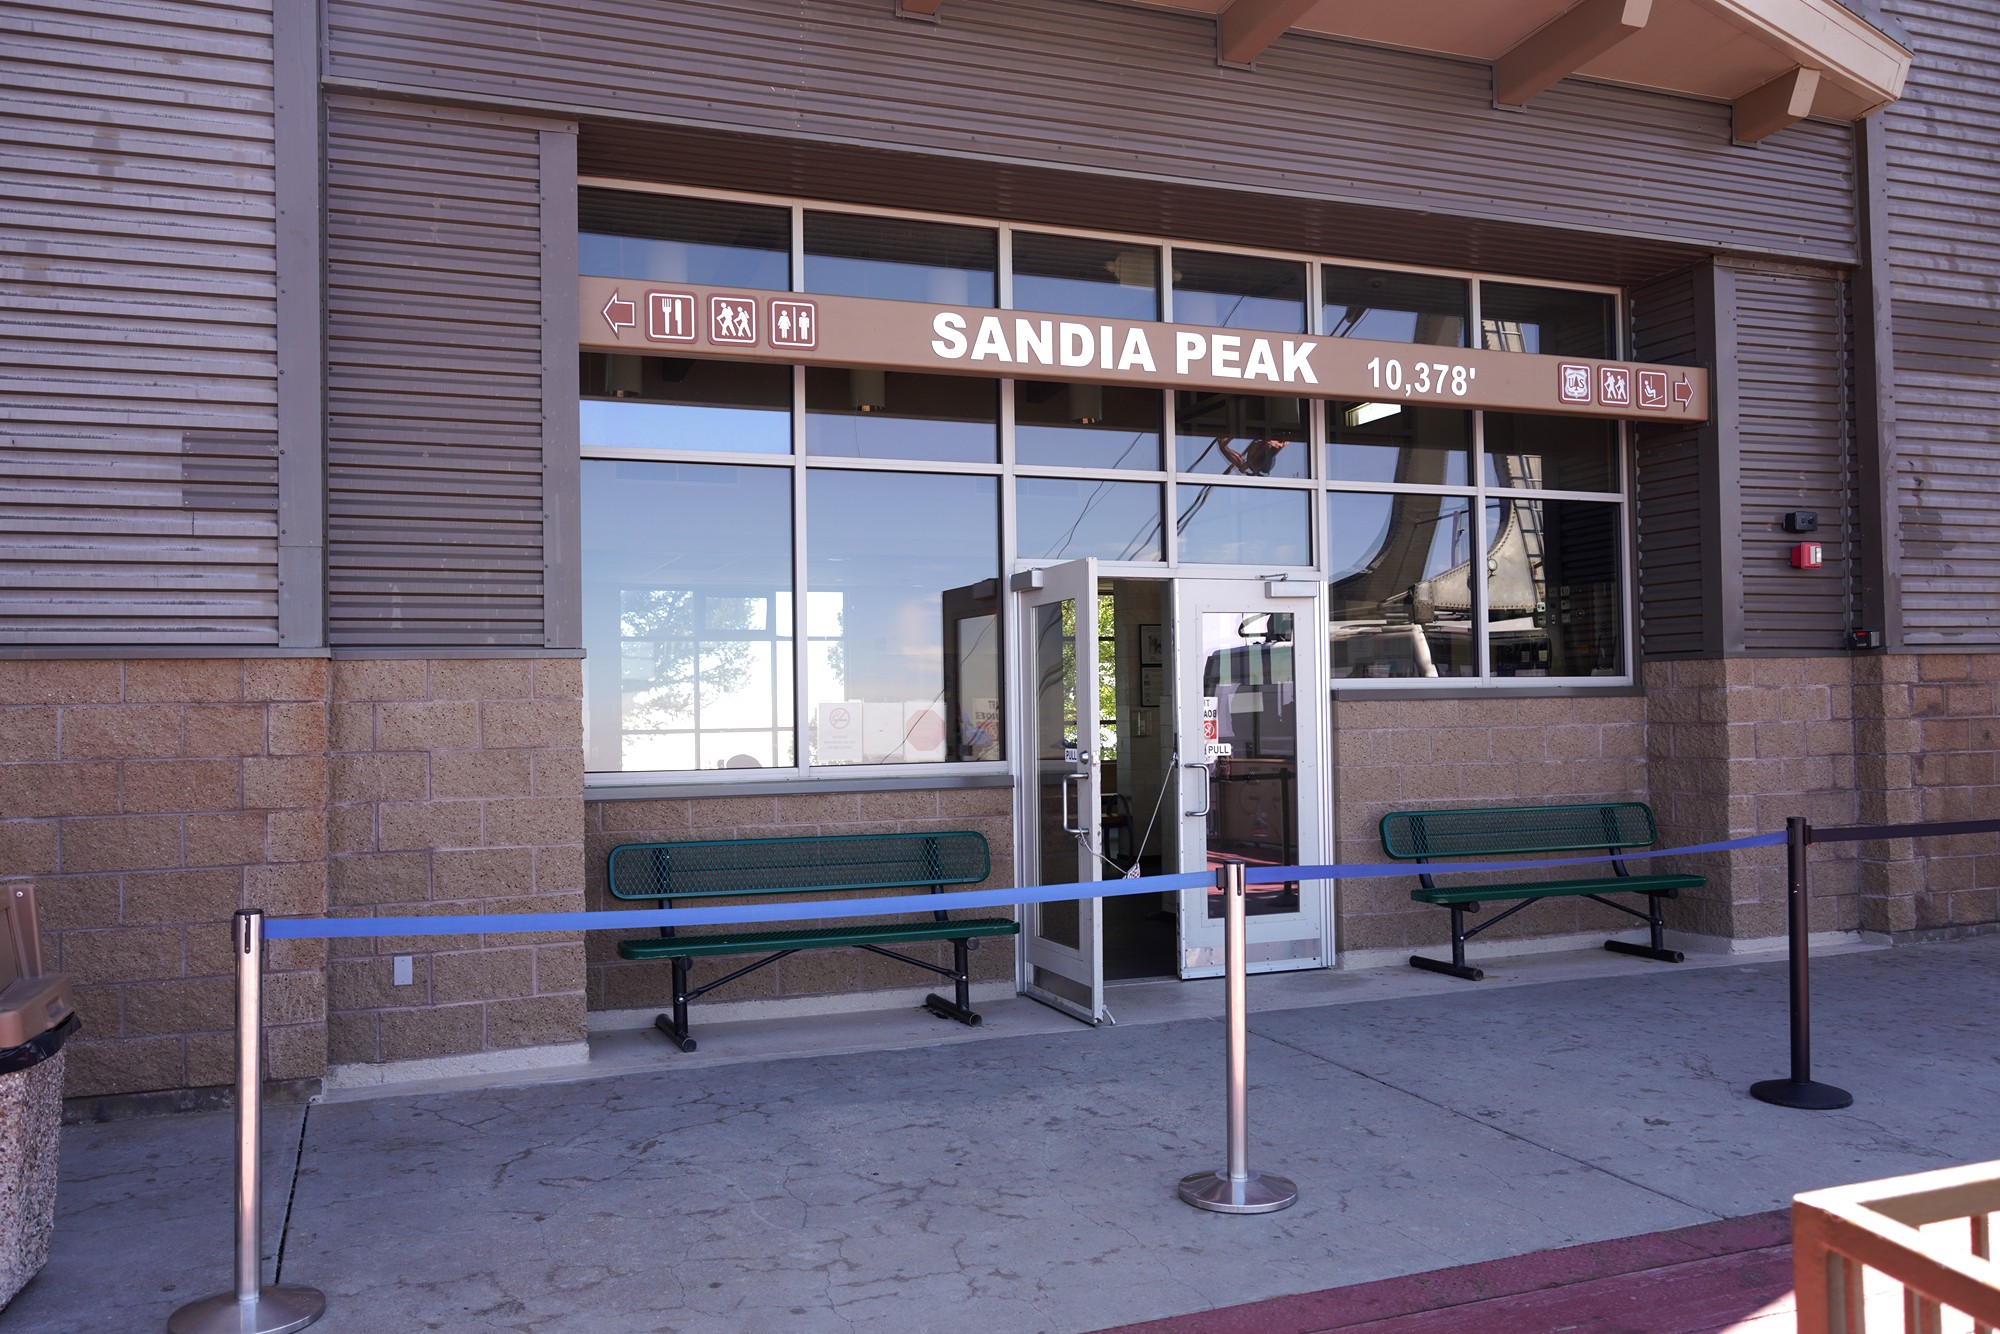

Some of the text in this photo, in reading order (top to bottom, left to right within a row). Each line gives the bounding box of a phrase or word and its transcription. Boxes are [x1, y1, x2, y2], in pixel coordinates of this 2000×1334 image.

[931, 312, 1476, 397] SANDIA PEAK 10,378'
[1208, 745, 1229, 754] PULL
